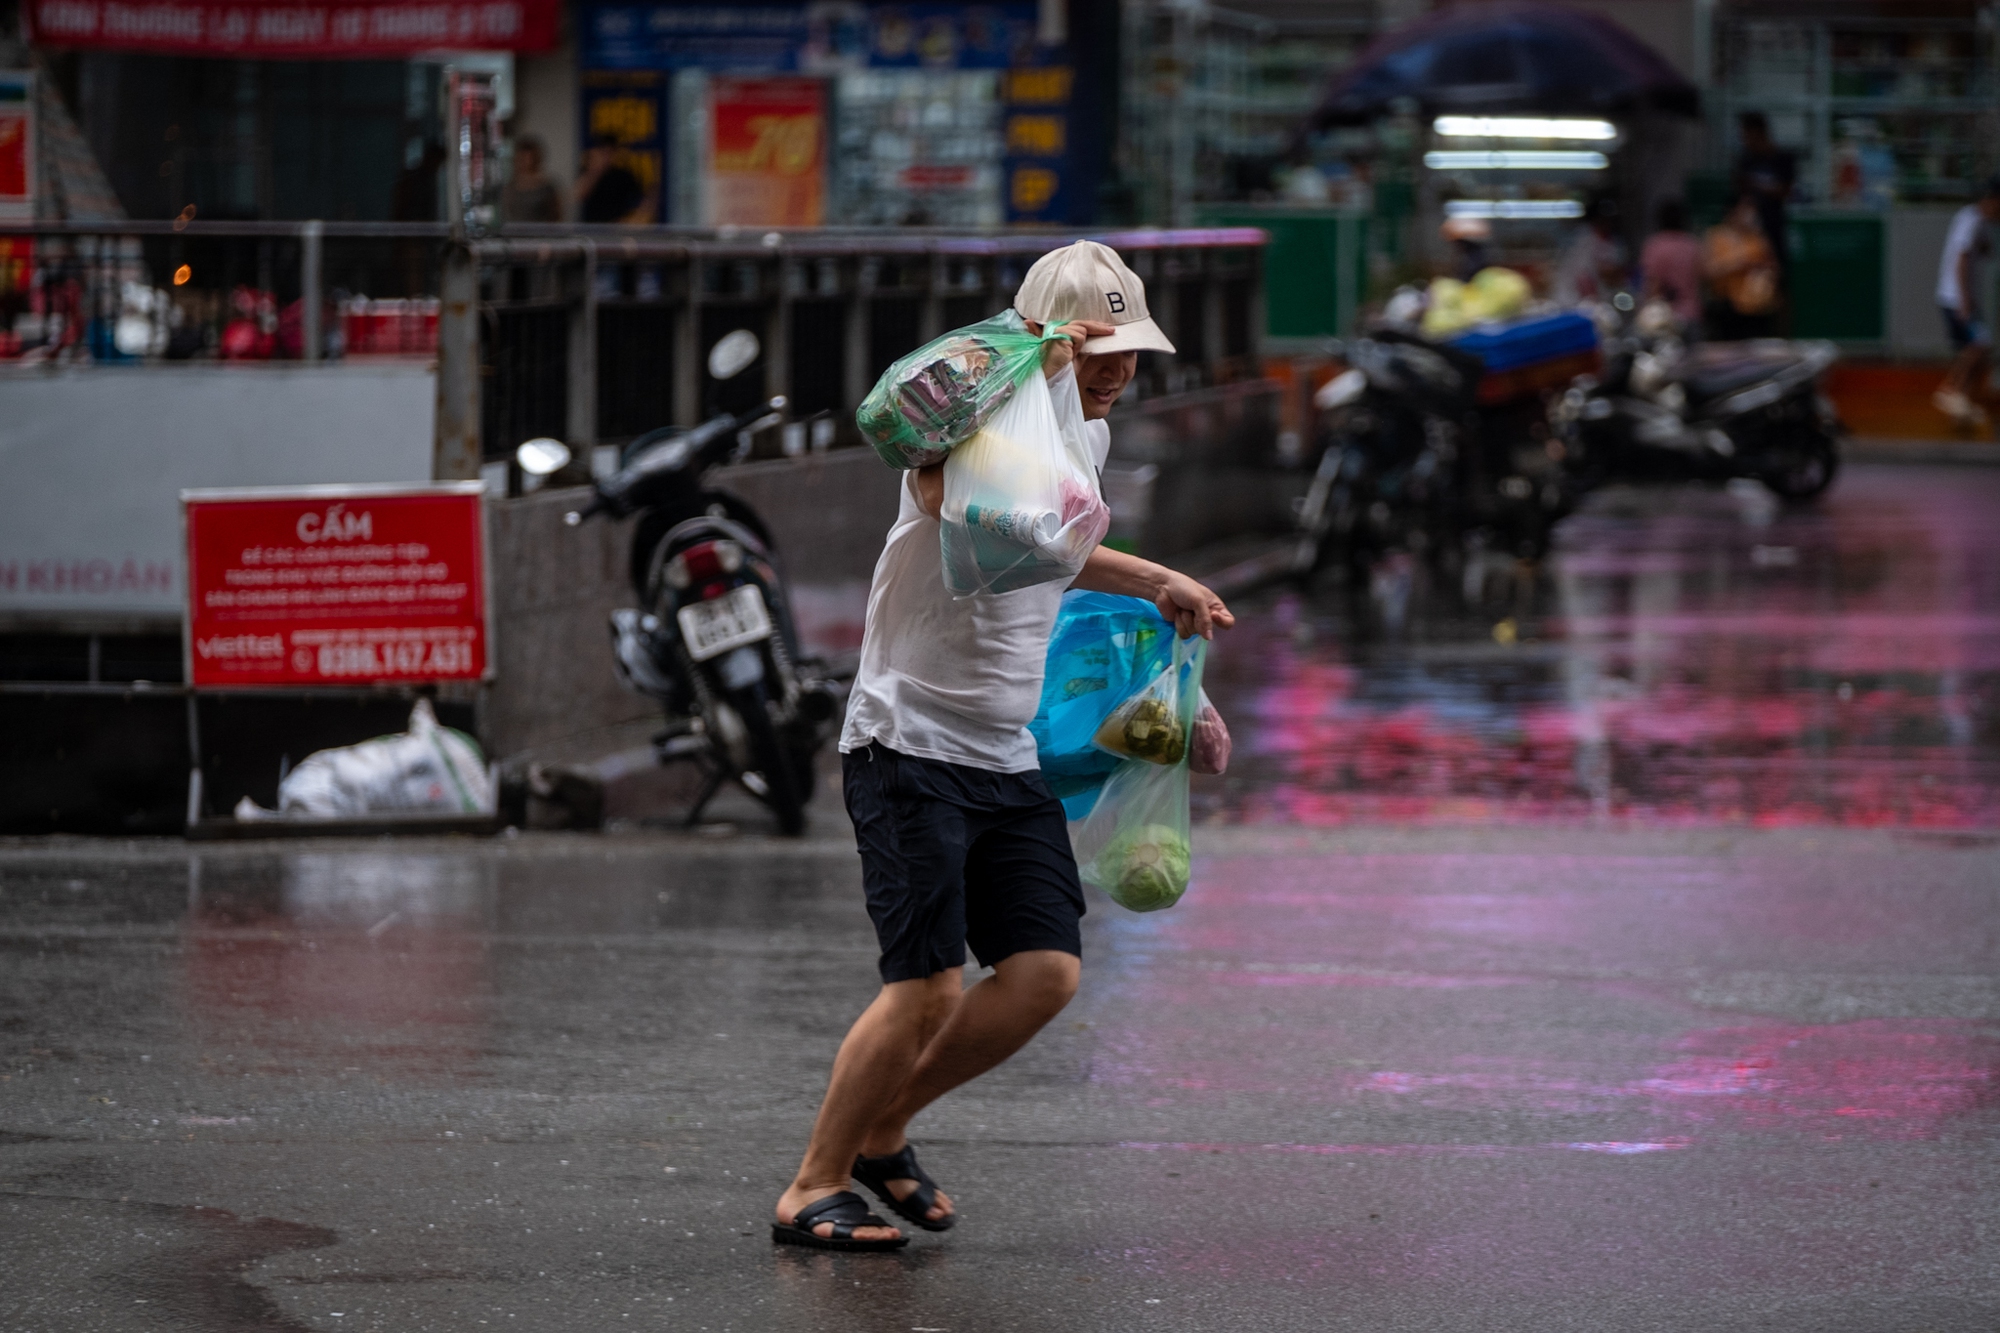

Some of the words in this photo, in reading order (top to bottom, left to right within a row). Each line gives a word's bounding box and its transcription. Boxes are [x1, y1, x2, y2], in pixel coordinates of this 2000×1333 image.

[1105, 292, 1125, 314] B
[296, 503, 373, 543] CẤM
[197, 633, 285, 659] viettel
